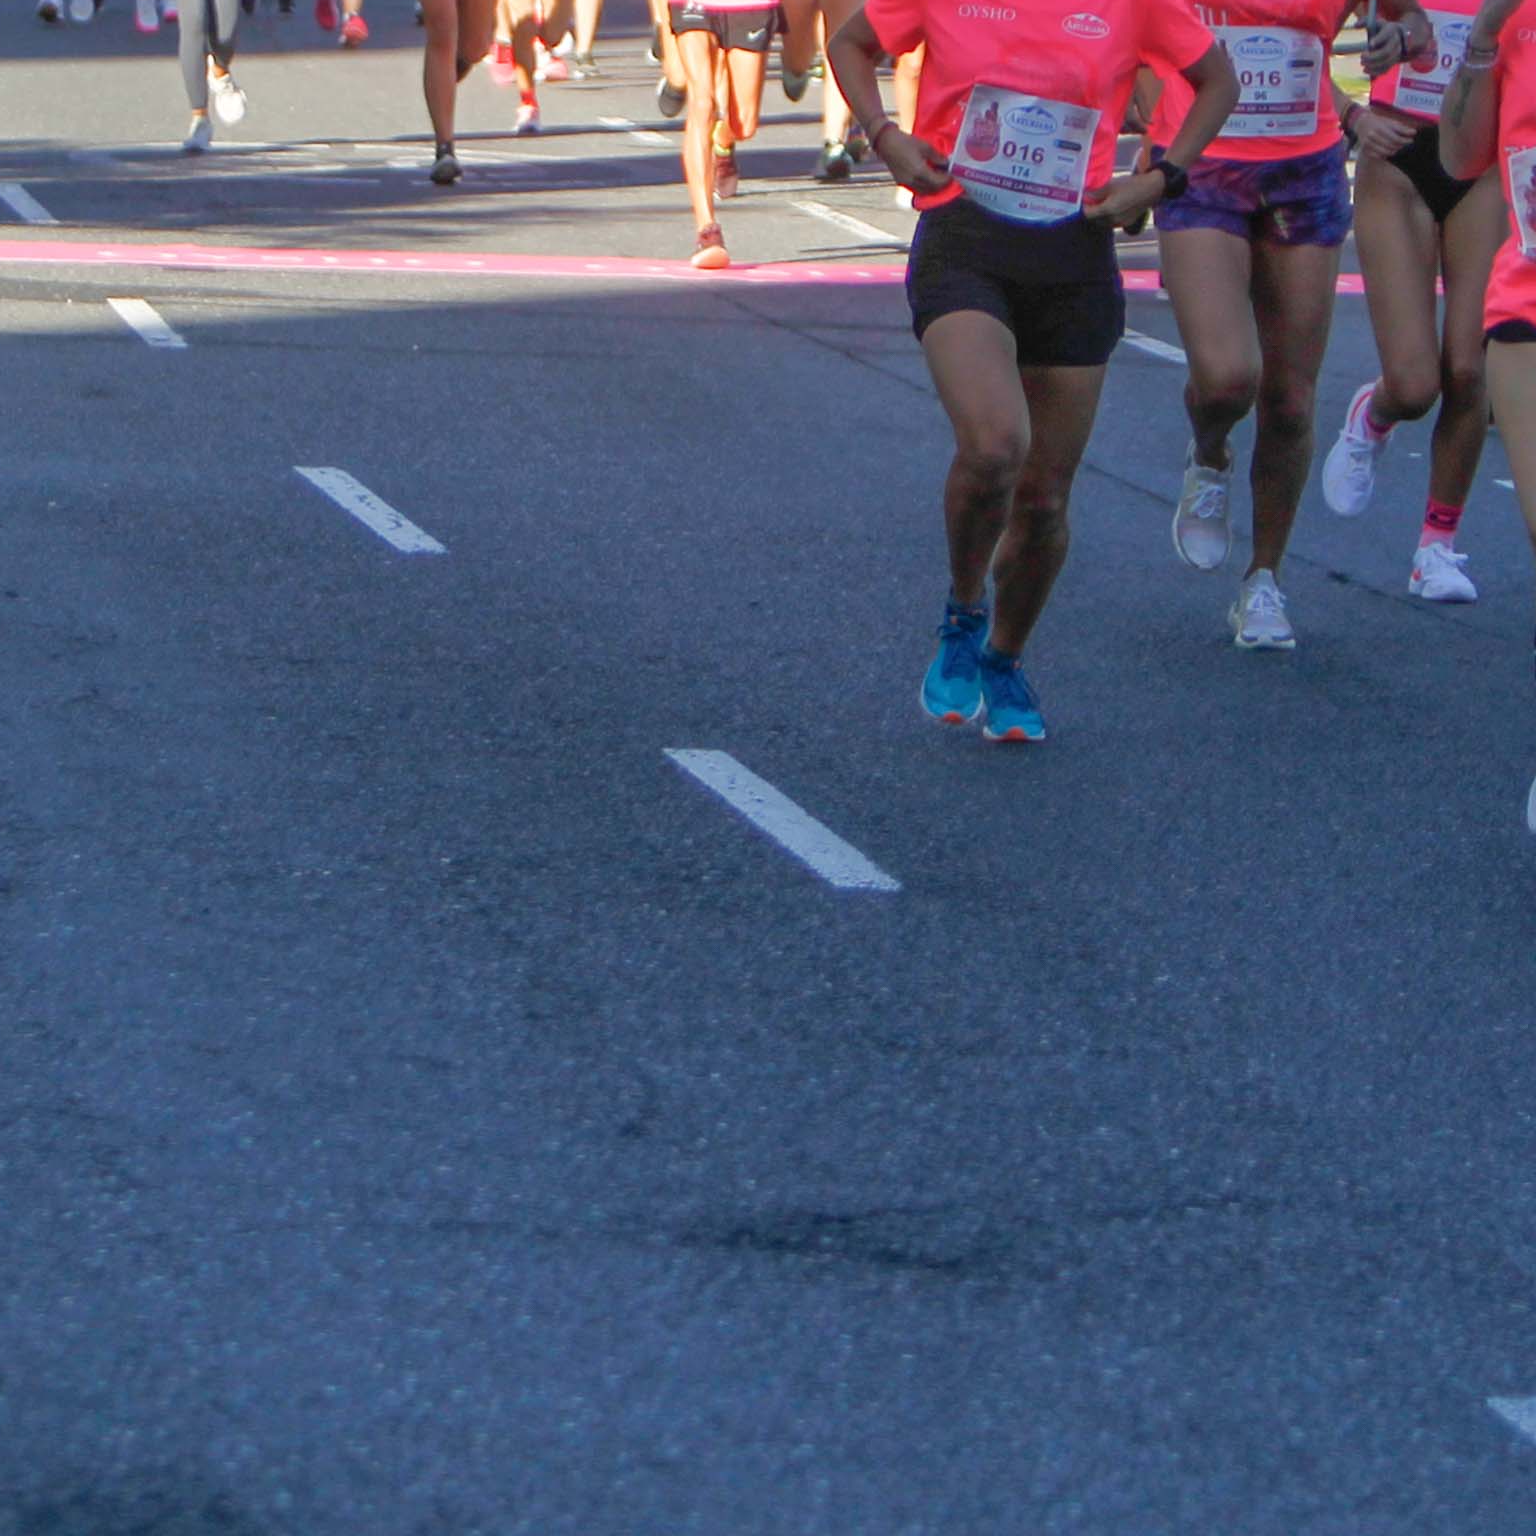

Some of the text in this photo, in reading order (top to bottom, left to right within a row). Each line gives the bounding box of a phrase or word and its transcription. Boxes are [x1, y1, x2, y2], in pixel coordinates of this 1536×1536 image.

[958, 4, 1016, 22] OYSHO
[1241, 70, 1281, 86] 016
[1002, 140, 1045, 164] 016
